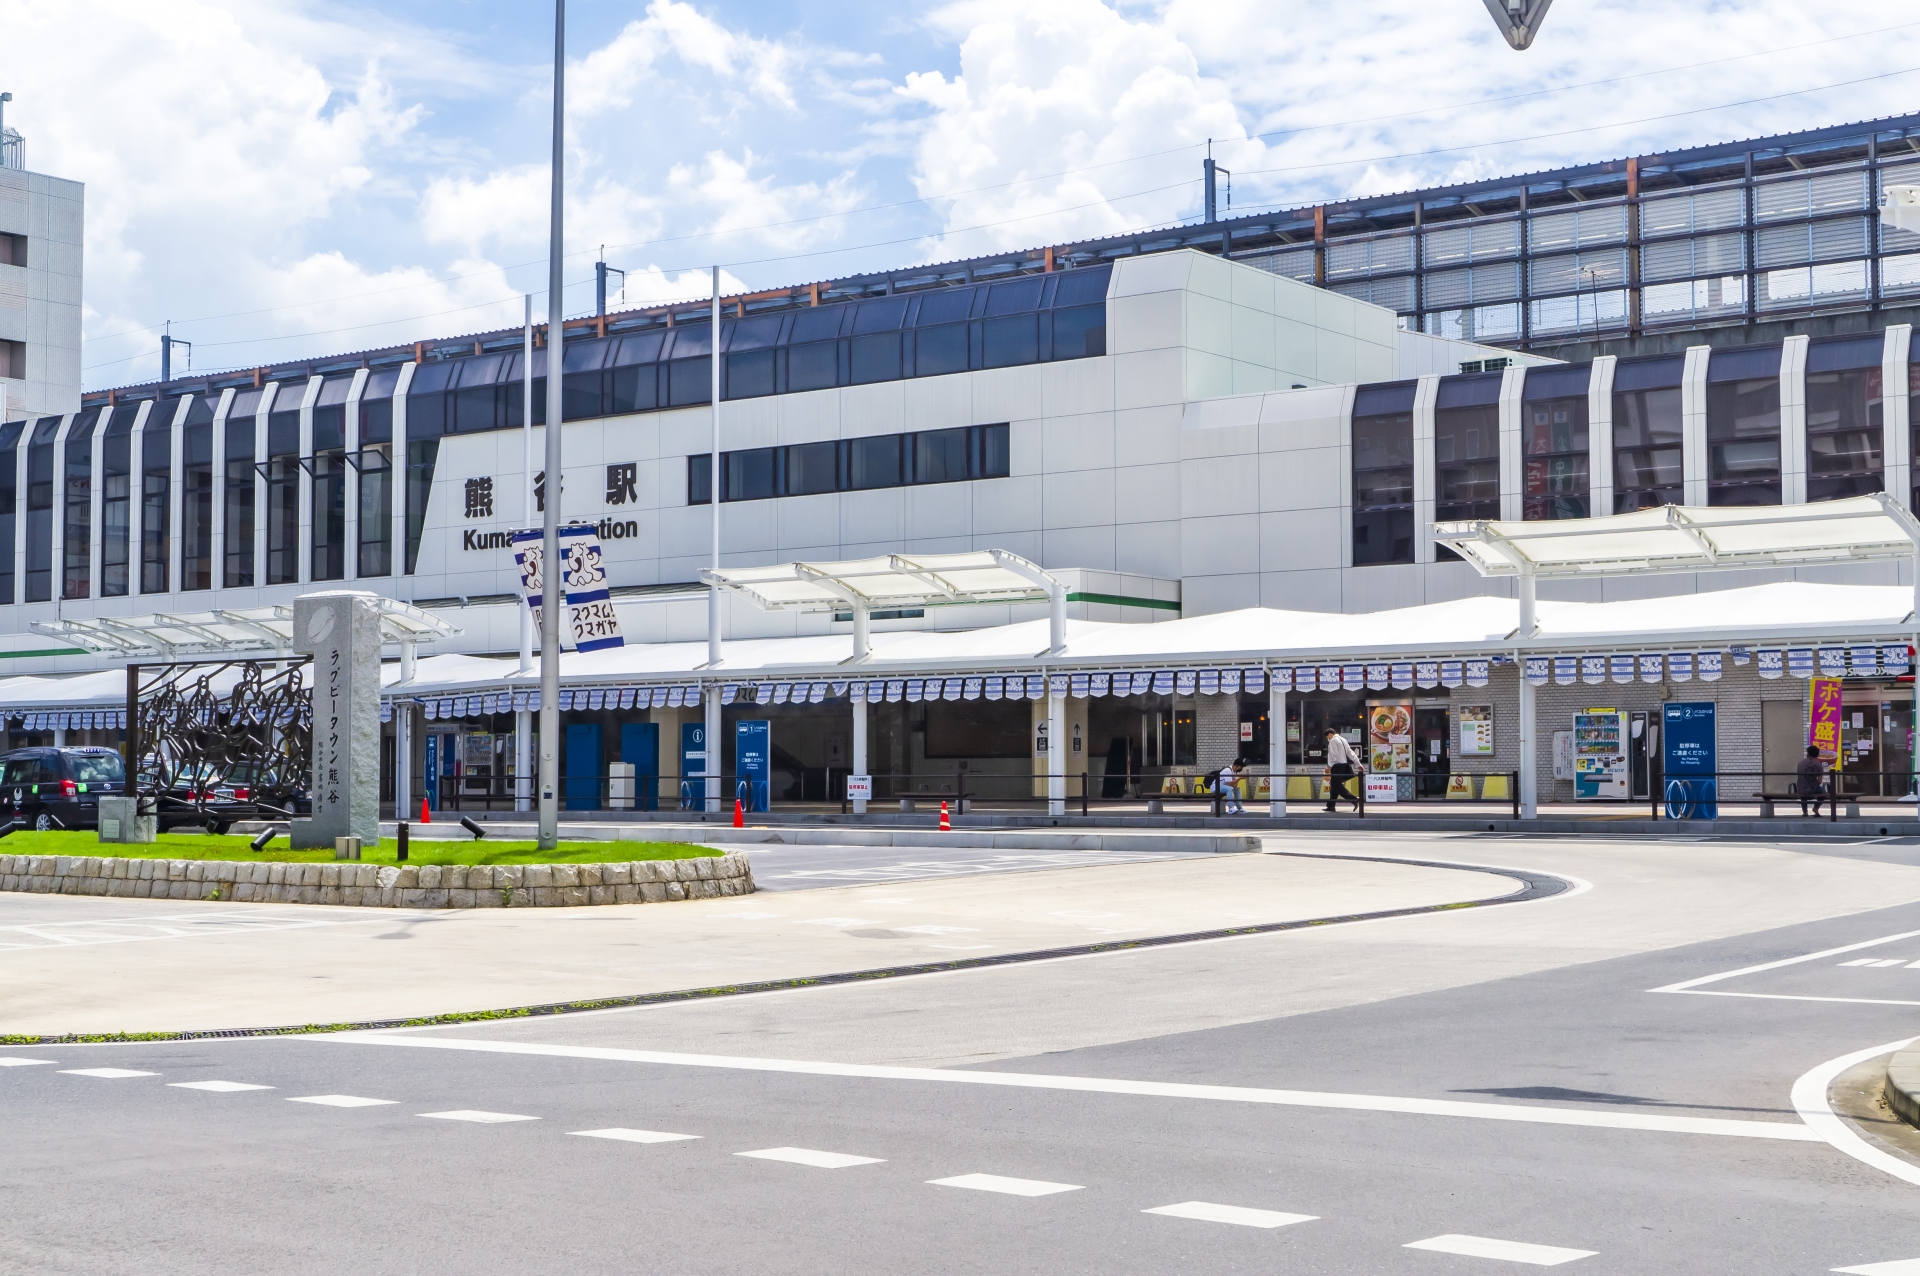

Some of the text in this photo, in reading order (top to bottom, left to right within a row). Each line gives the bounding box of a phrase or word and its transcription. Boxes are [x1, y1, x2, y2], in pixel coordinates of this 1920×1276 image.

[574, 619, 617, 640] クマガヤ
[326, 649, 340, 804] ラグビータウン熊谷
[1685, 709, 1691, 717] 2
[1814, 682, 1841, 741] ポケ盛
